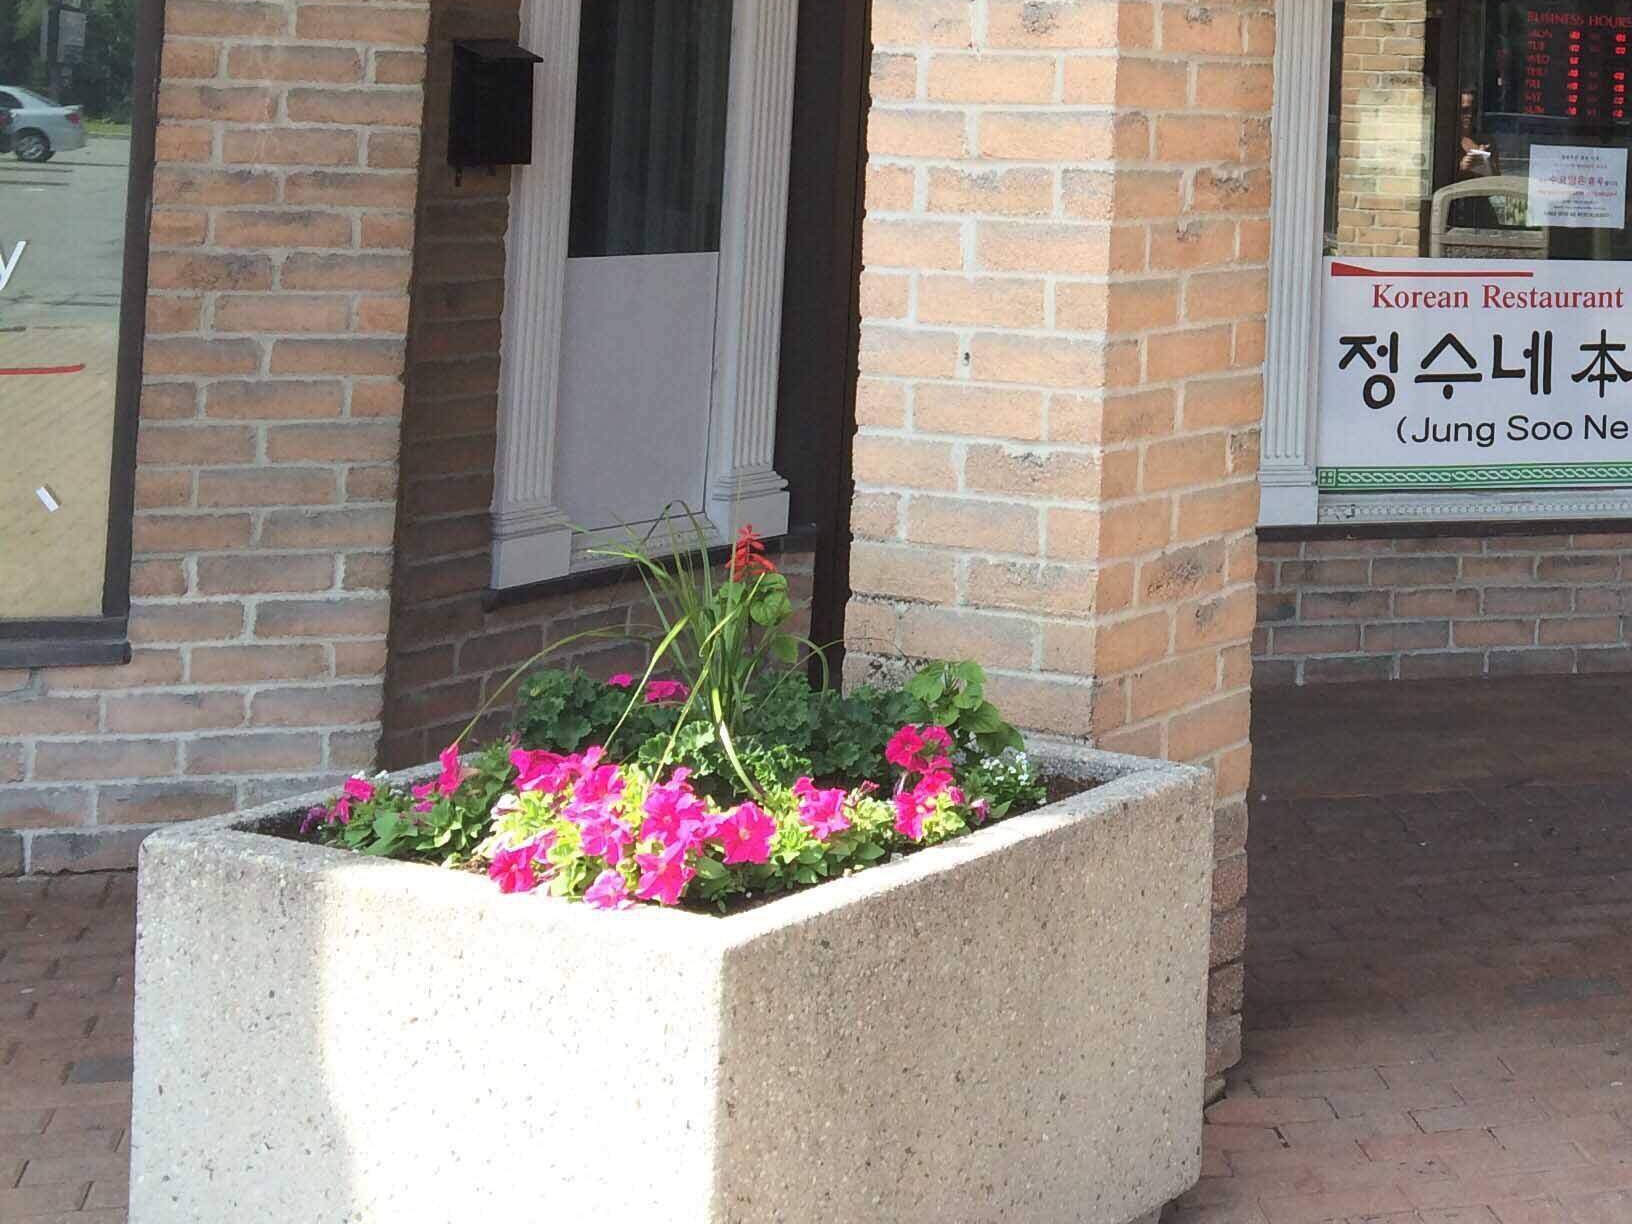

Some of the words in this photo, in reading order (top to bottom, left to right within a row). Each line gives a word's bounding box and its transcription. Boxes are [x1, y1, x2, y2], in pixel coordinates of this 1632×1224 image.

[1372, 283, 1470, 309] Korean
[1481, 284, 1625, 310] Restaurant
[1396, 415, 1496, 448] (Jung
[1506, 414, 1574, 442] Soo
